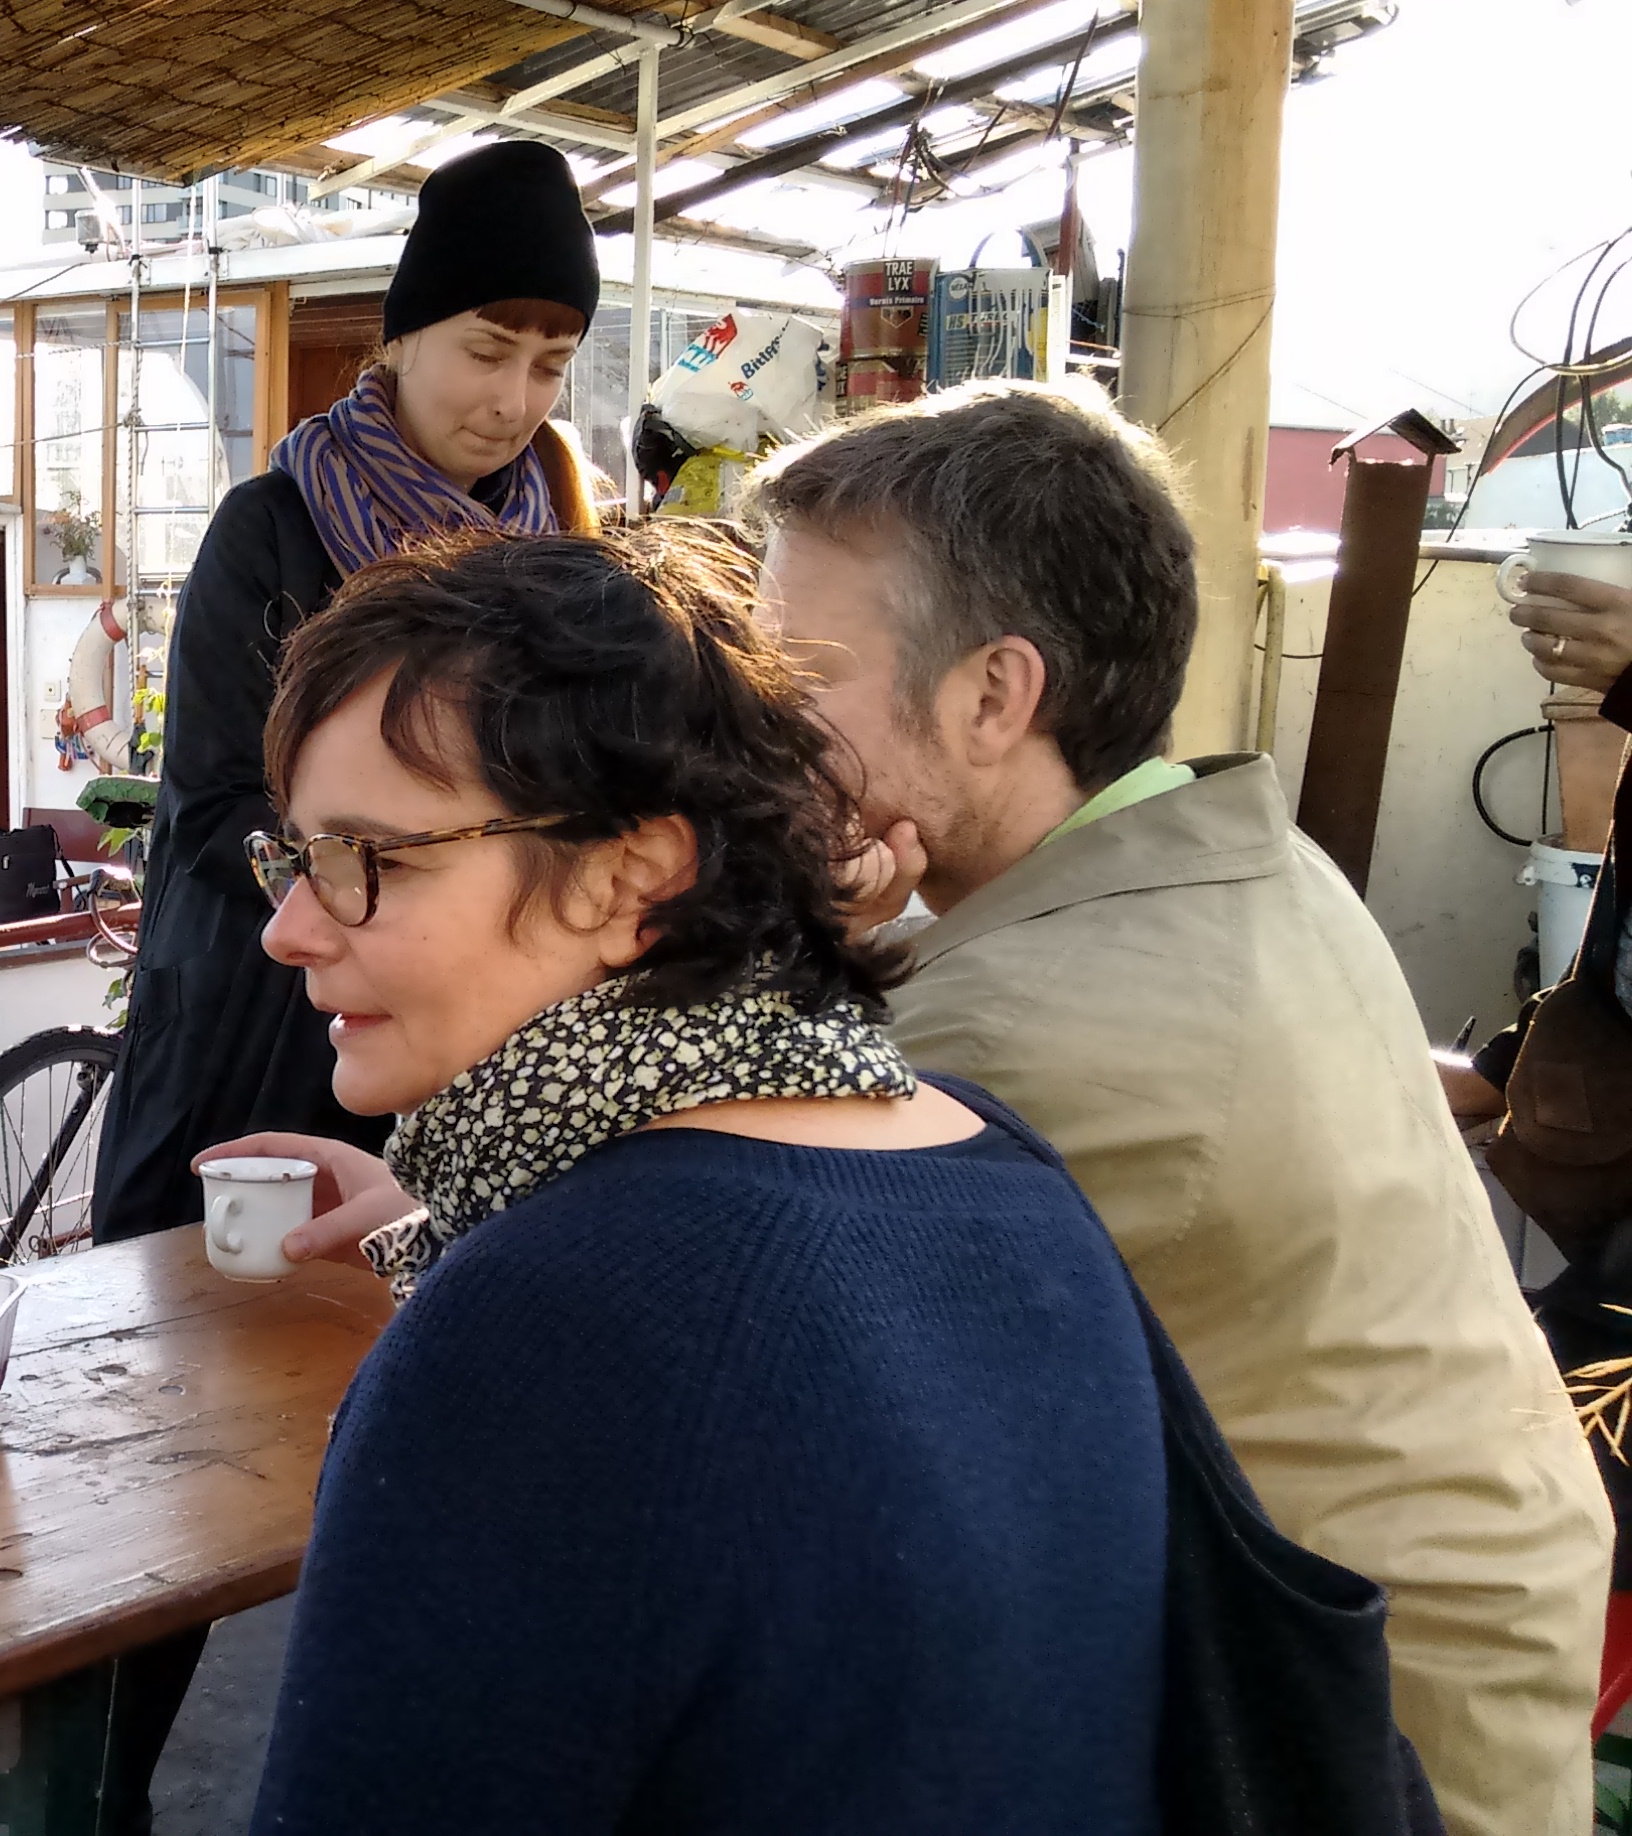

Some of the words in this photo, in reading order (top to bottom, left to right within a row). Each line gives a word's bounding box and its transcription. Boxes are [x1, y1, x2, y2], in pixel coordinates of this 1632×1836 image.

[885, 261, 913, 276] TRAE
[888, 276, 909, 291] LYX
[948, 315, 965, 329] HS
